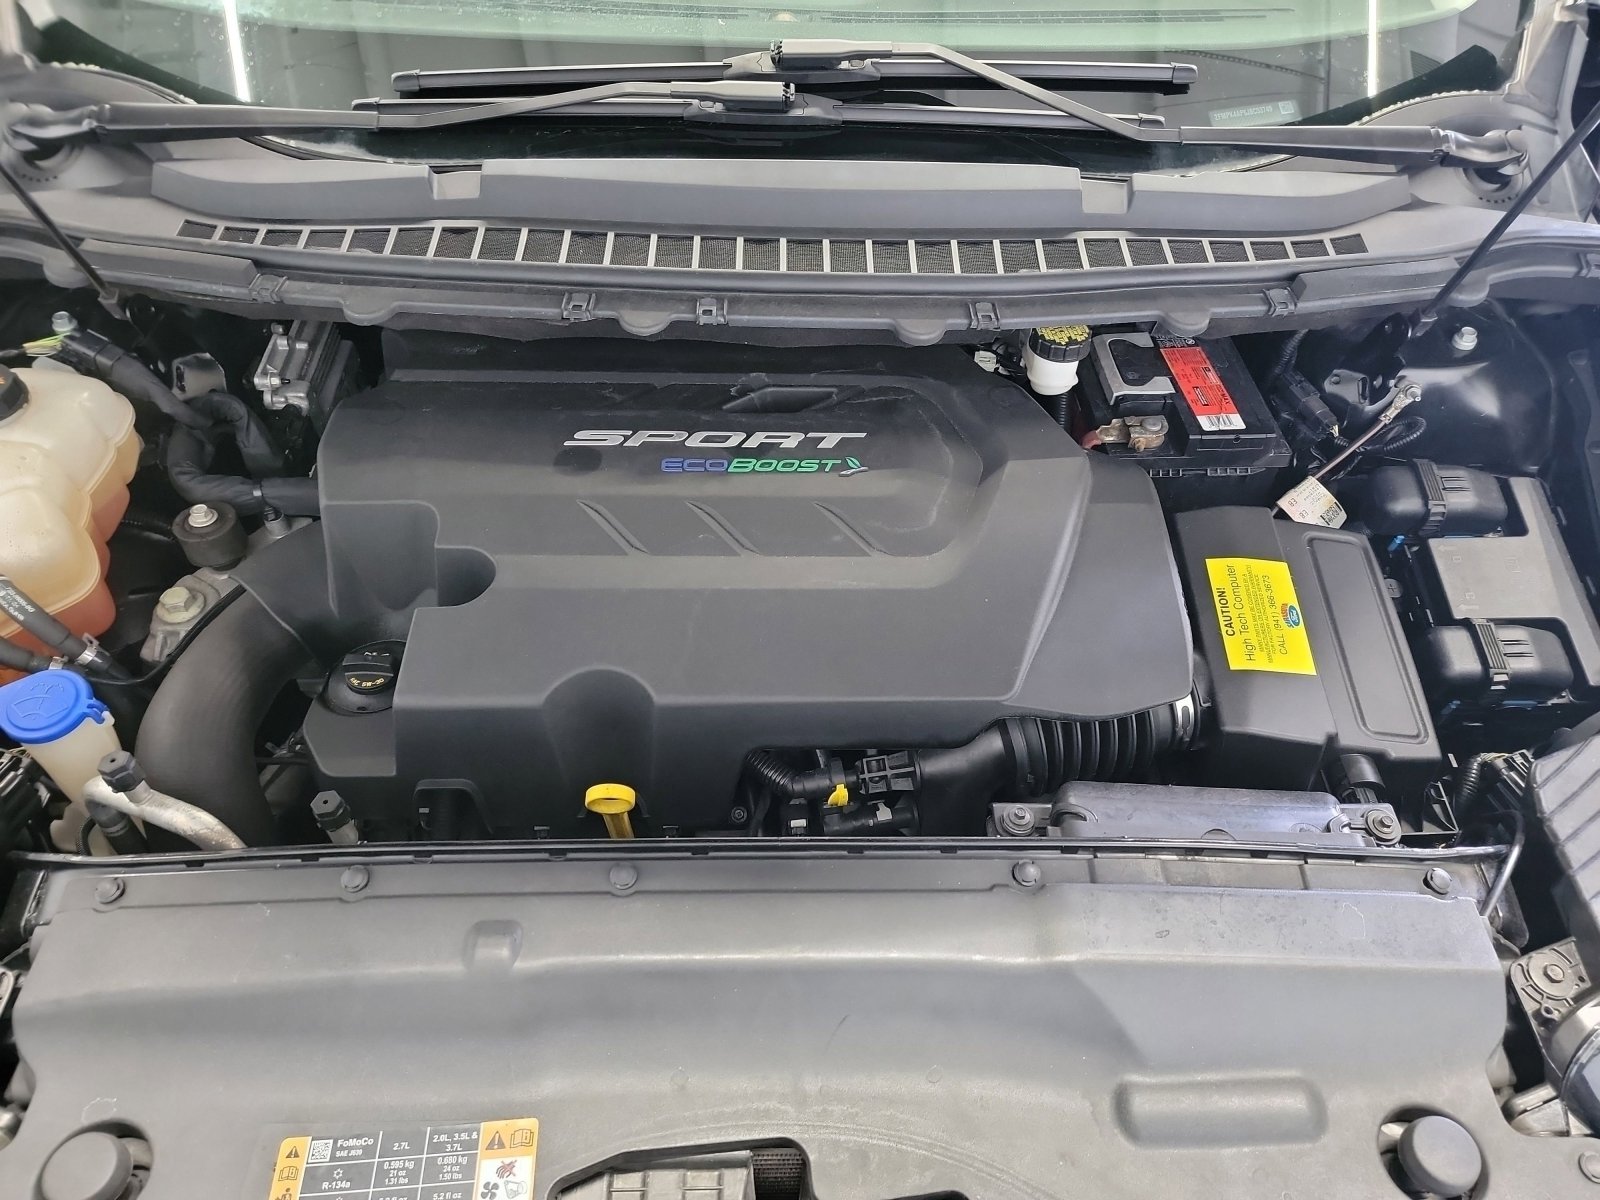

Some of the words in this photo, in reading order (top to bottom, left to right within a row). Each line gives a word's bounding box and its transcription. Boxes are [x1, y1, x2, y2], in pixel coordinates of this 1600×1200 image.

[563, 430, 867, 448] SPORT
[1227, 564, 1244, 610] Computer
[1261, 574, 1277, 609] 366-3673
[1216, 587, 1236, 637] CAUTION!
[1270, 611, 1283, 631] (941)
[1236, 612, 1250, 635] Tech
[1243, 638, 1256, 661] High
[1276, 633, 1288, 655] CALL
[337, 1137, 374, 1148] FoMoCo
[433, 1134, 452, 1142] 2.0L,
[454, 1132, 470, 1140] 3.5L
[472, 1131, 478, 1139] &
[393, 1142, 411, 1150] 2.7L
[446, 1144, 462, 1152] 3.7L
[384, 1160, 404, 1169] 0.595
[404, 1160, 414, 1170] kg
[438, 1156, 457, 1165] 0.680
[458, 1155, 468, 1164] kg
[322, 1180, 351, 1190] R-134a
